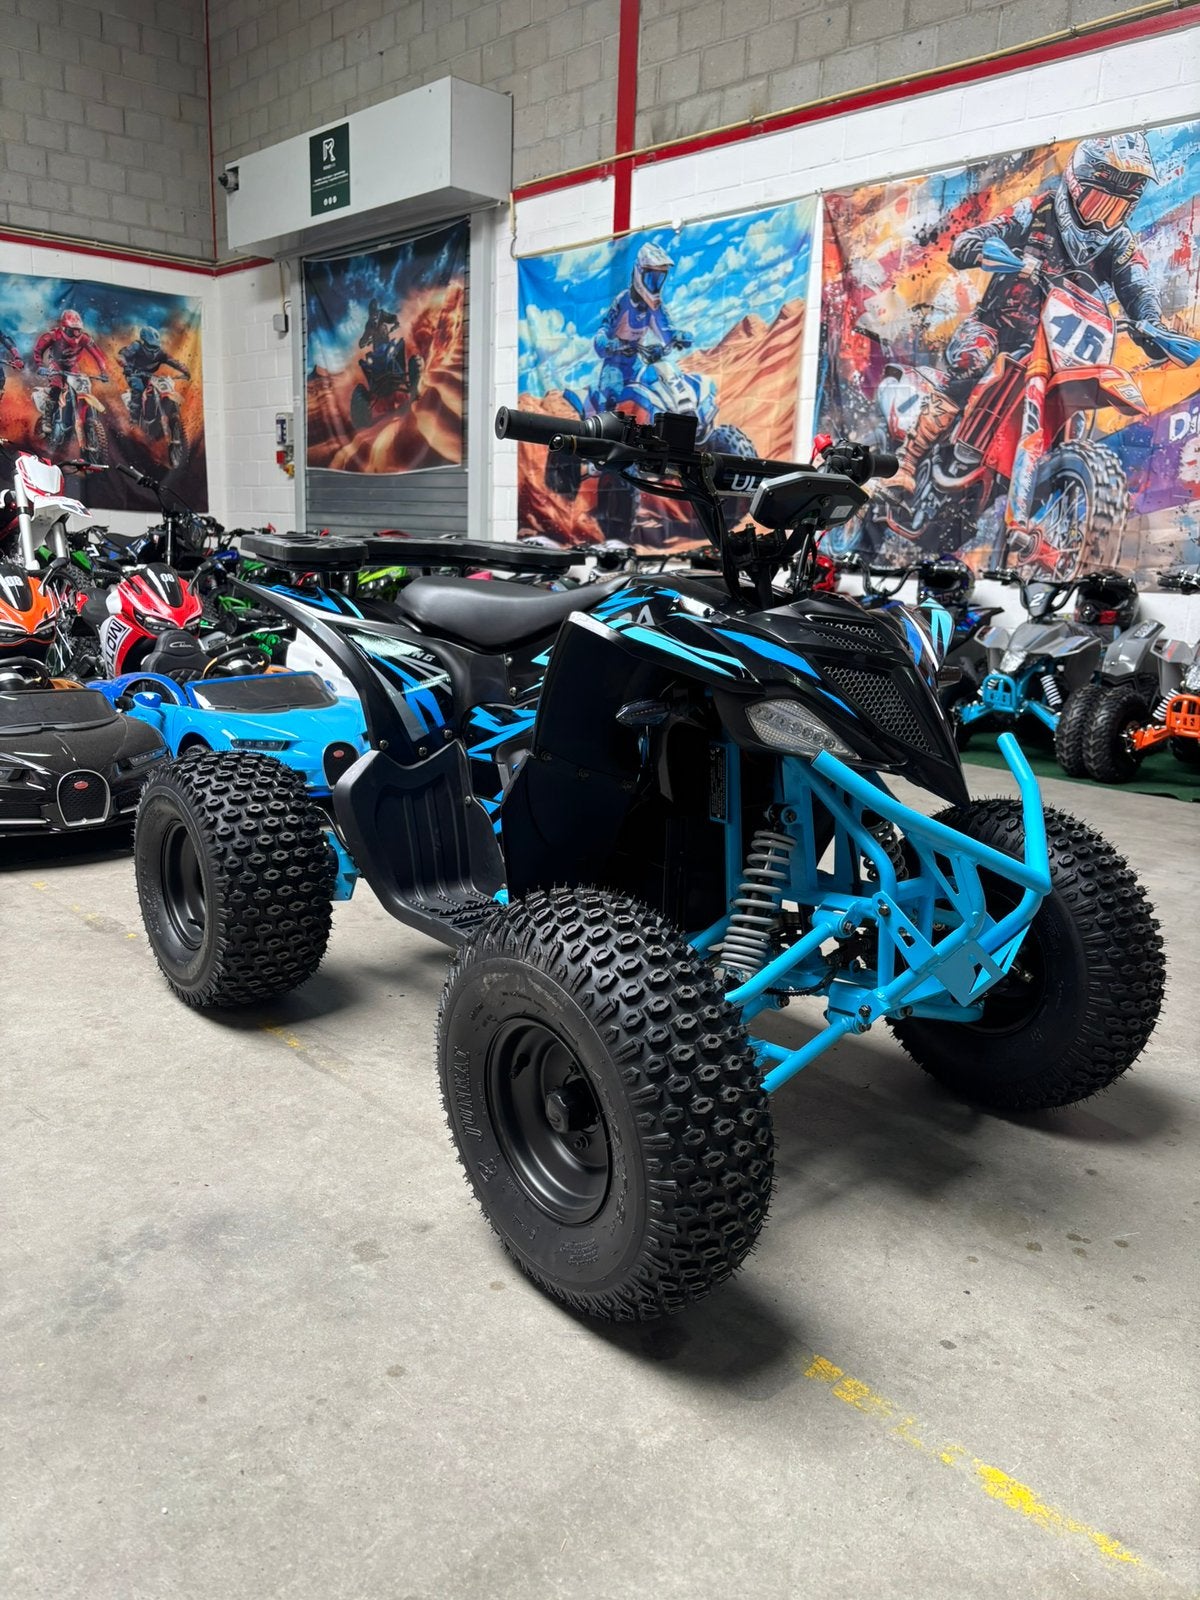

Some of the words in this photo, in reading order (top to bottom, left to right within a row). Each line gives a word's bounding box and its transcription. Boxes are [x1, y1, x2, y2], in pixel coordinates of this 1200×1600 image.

[1168, 406, 1200, 443] Di
[731, 474, 764, 492] UL
[160, 573, 175, 583] 08
[1029, 592, 1045, 607] 2
